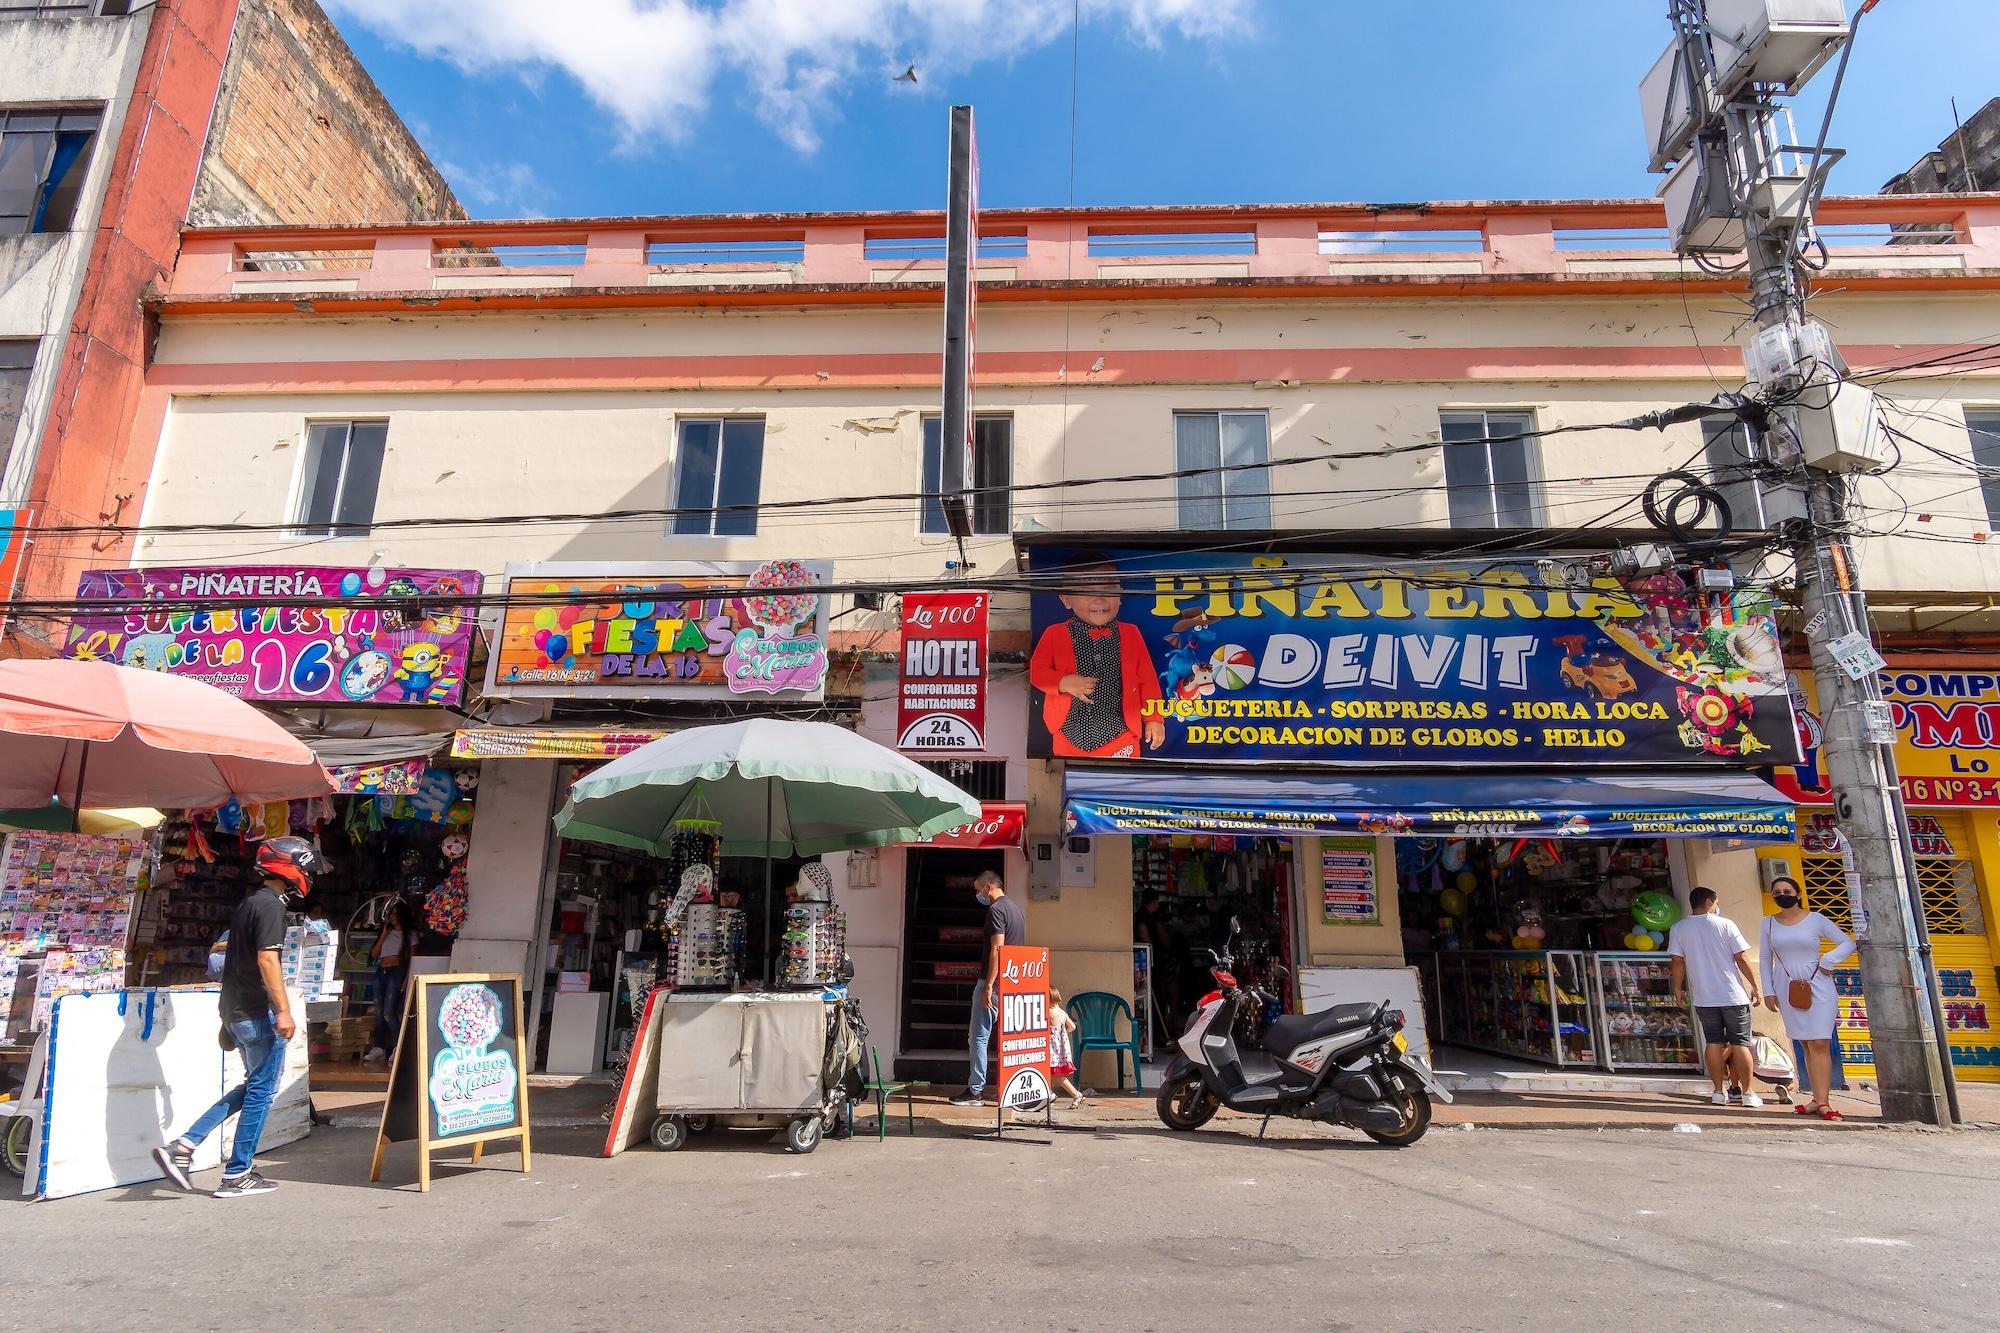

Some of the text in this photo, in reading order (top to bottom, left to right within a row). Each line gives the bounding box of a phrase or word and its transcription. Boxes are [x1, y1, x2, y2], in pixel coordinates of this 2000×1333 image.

[906, 604, 934, 629] La
[571, 616, 736, 657] FIESTAS
[757, 639, 820, 653] GLOBOS
[600, 654, 701, 678] DE LA 16
[905, 638, 981, 678] HOTEL
[1258, 633, 1539, 690] DEIVIT
[165, 638, 335, 697] DE LA 16
[520, 668, 543, 680] Calle
[546, 669, 558, 680] 16
[573, 669, 596, 680] 3-24
[903, 683, 977, 696] CONFORTABLES
[1878, 673, 2000, 697] COMP
[903, 698, 976, 710] HABITACIONES
[1140, 699, 1670, 720] JUGUETERIA SORPRESAS HORA LOCA
[930, 720, 952, 735] 24
[915, 736, 966, 747] HORAS
[1186, 726, 1626, 747] DECORACION DE GLOBOS HELIO
[470, 743, 528, 755] SORPRESAS
[1900, 779, 1929, 801] 16
[1094, 806, 1338, 822] JUGUETERIA SORPRESAS HORA LOCA
[1430, 807, 1542, 821] PIÑATERIA
[1609, 812, 1692, 821] JUGUETERIA
[1699, 812, 1774, 821] SORPRESAS
[1116, 818, 1198, 829] DECORACION
[1199, 820, 1217, 829] DE
[1219, 820, 1268, 829] GLOBOS
[1632, 823, 1789, 834] DECORACION DE GLOBOS
[1002, 959, 1020, 984] La
[1003, 993, 1048, 1033] HOTEL
[1336, 1014, 1360, 1024] YAMAHA
[1002, 1036, 1047, 1053] CONFORTABLES
[1003, 1051, 1046, 1067] HABITACIONES
[456, 1059, 507, 1076] GLOBOS
[1020, 1074, 1033, 1090] 24
[1011, 1088, 1041, 1104] HORAS
